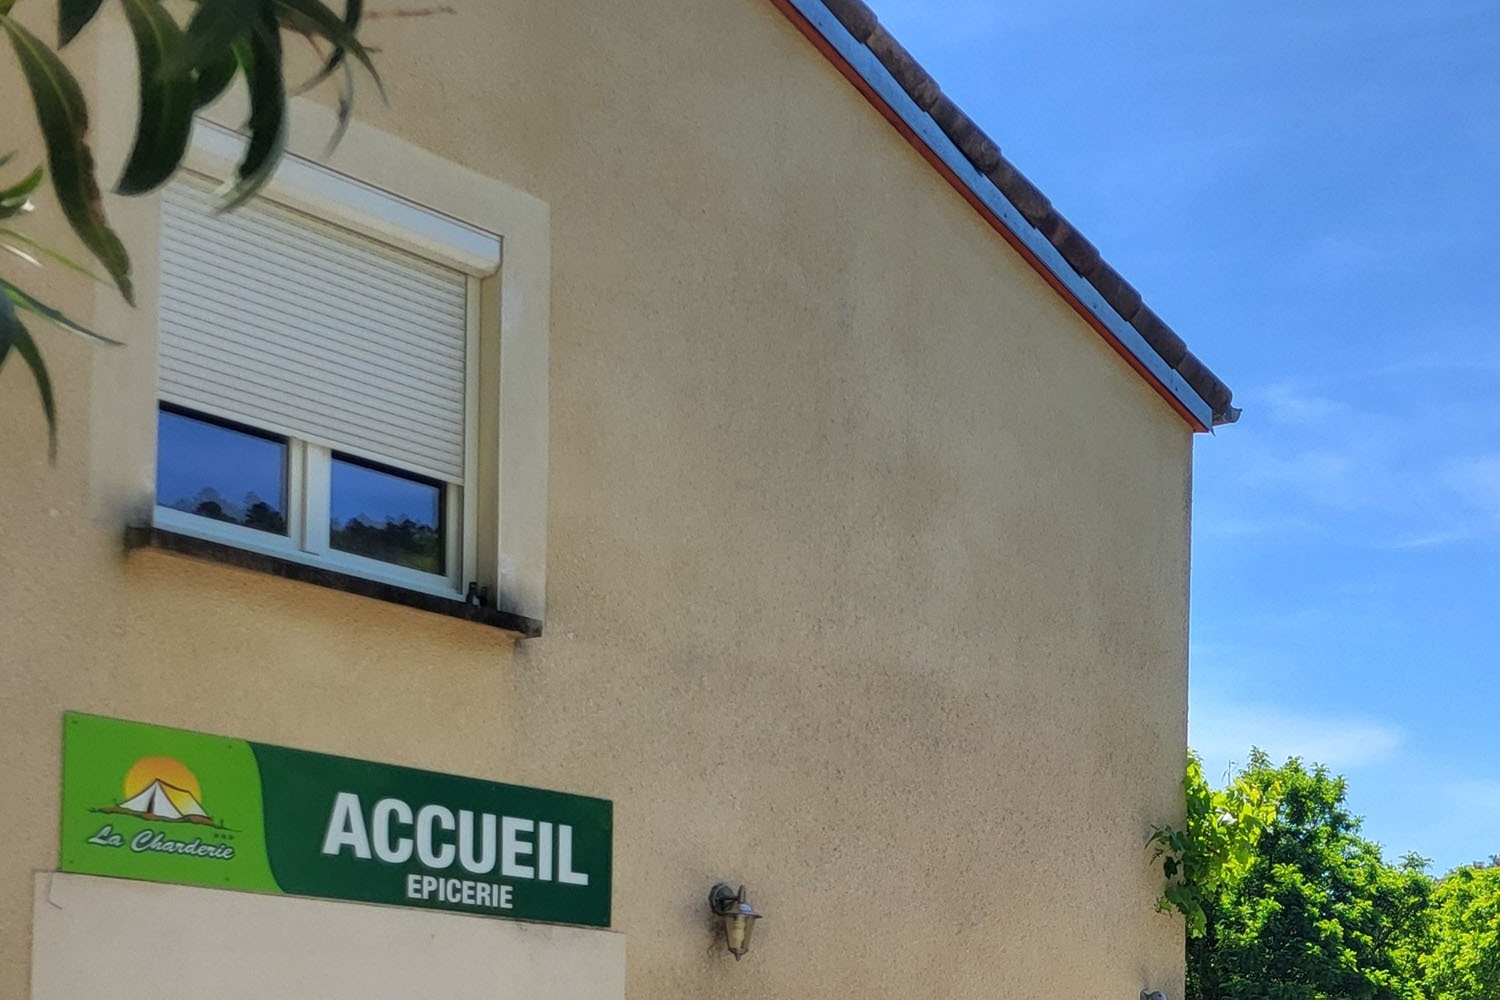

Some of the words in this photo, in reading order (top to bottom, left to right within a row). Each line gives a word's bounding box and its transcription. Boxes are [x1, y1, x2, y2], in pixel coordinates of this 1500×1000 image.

[87, 824, 124, 847] La
[130, 829, 236, 860] Charderie
[321, 790, 590, 886] ACCUEIL
[407, 874, 514, 909] EPICERIE
